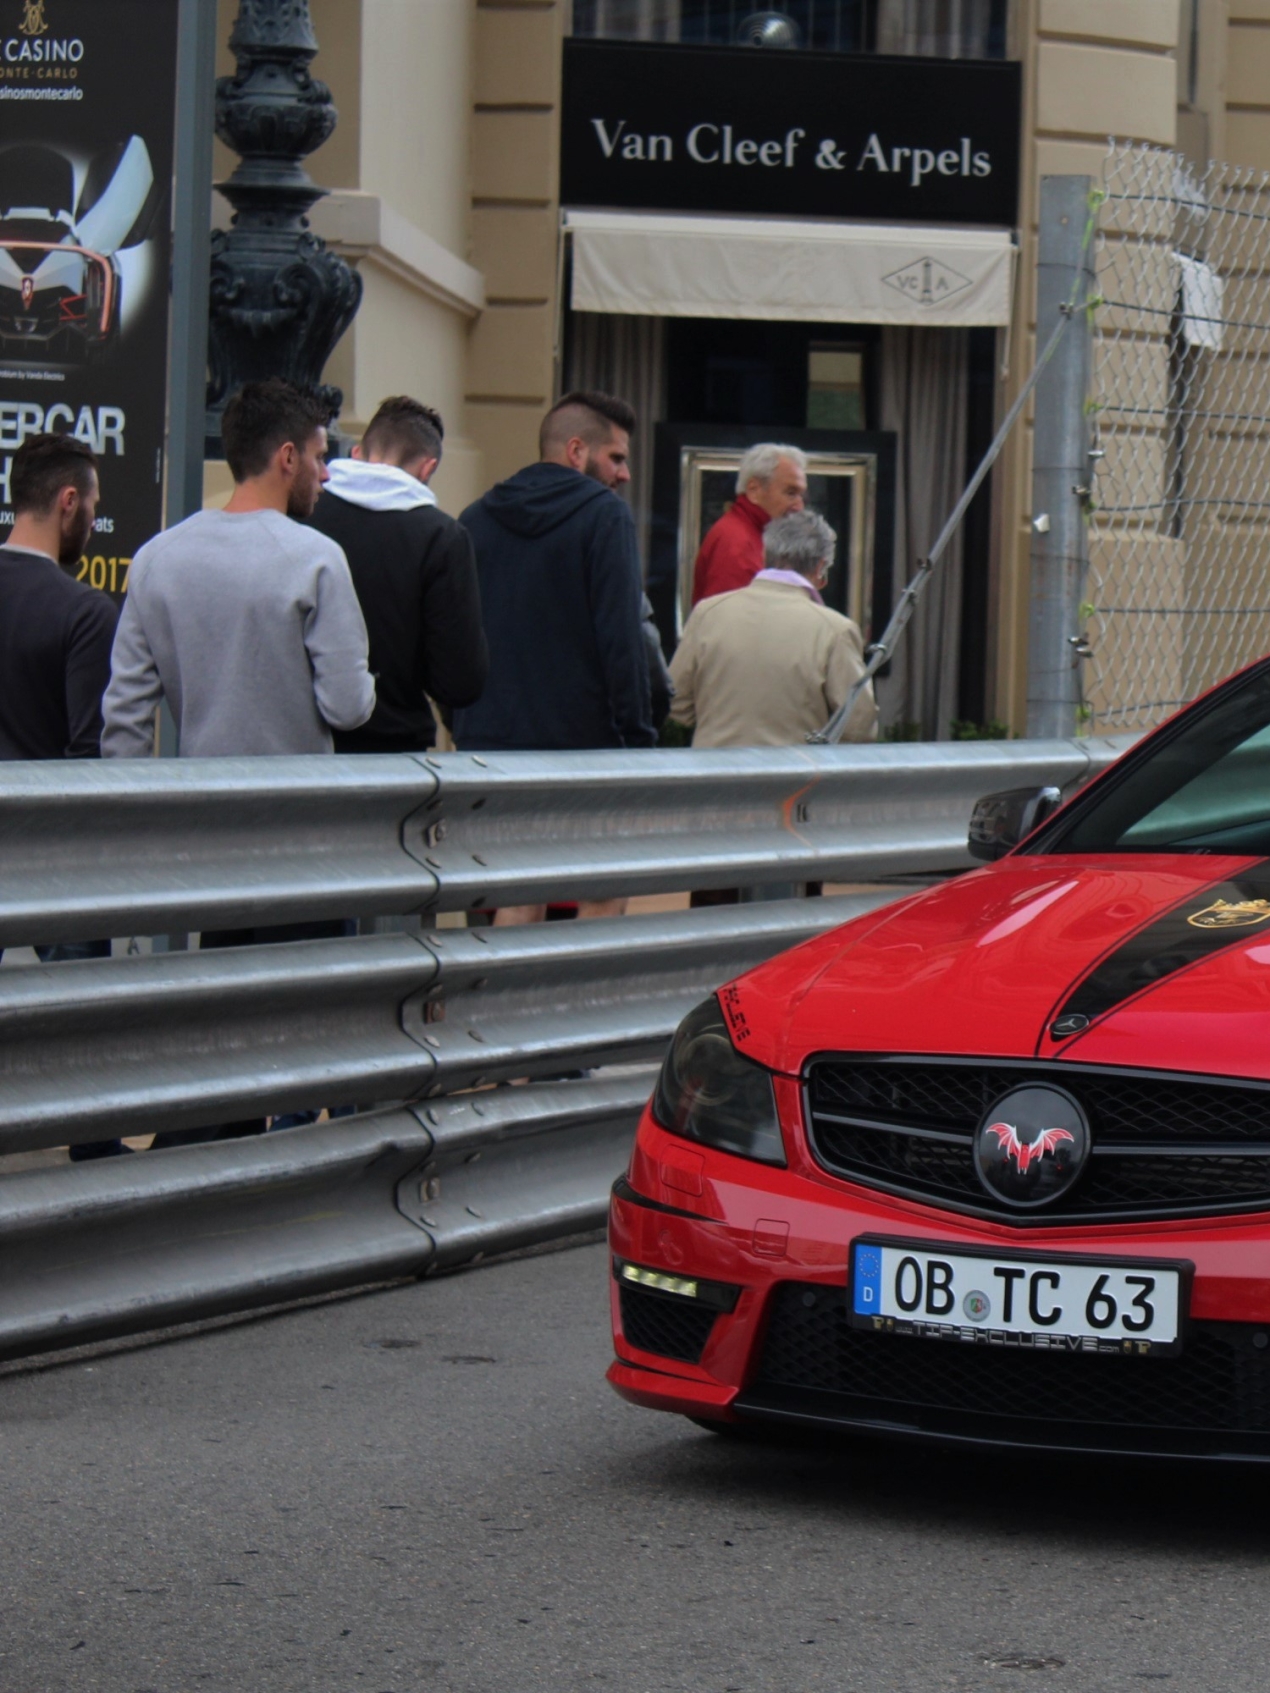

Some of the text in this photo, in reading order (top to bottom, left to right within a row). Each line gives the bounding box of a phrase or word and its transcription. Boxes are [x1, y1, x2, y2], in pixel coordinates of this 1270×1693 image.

[5, 38, 84, 62] CASINO
[592, 119, 992, 186] Van Cleef & Arpels
[76, 555, 132, 593] 2017
[862, 1286, 874, 1302] D
[895, 1256, 956, 1316] OB
[993, 1266, 1063, 1326] TC
[1085, 1273, 1156, 1332] 63
